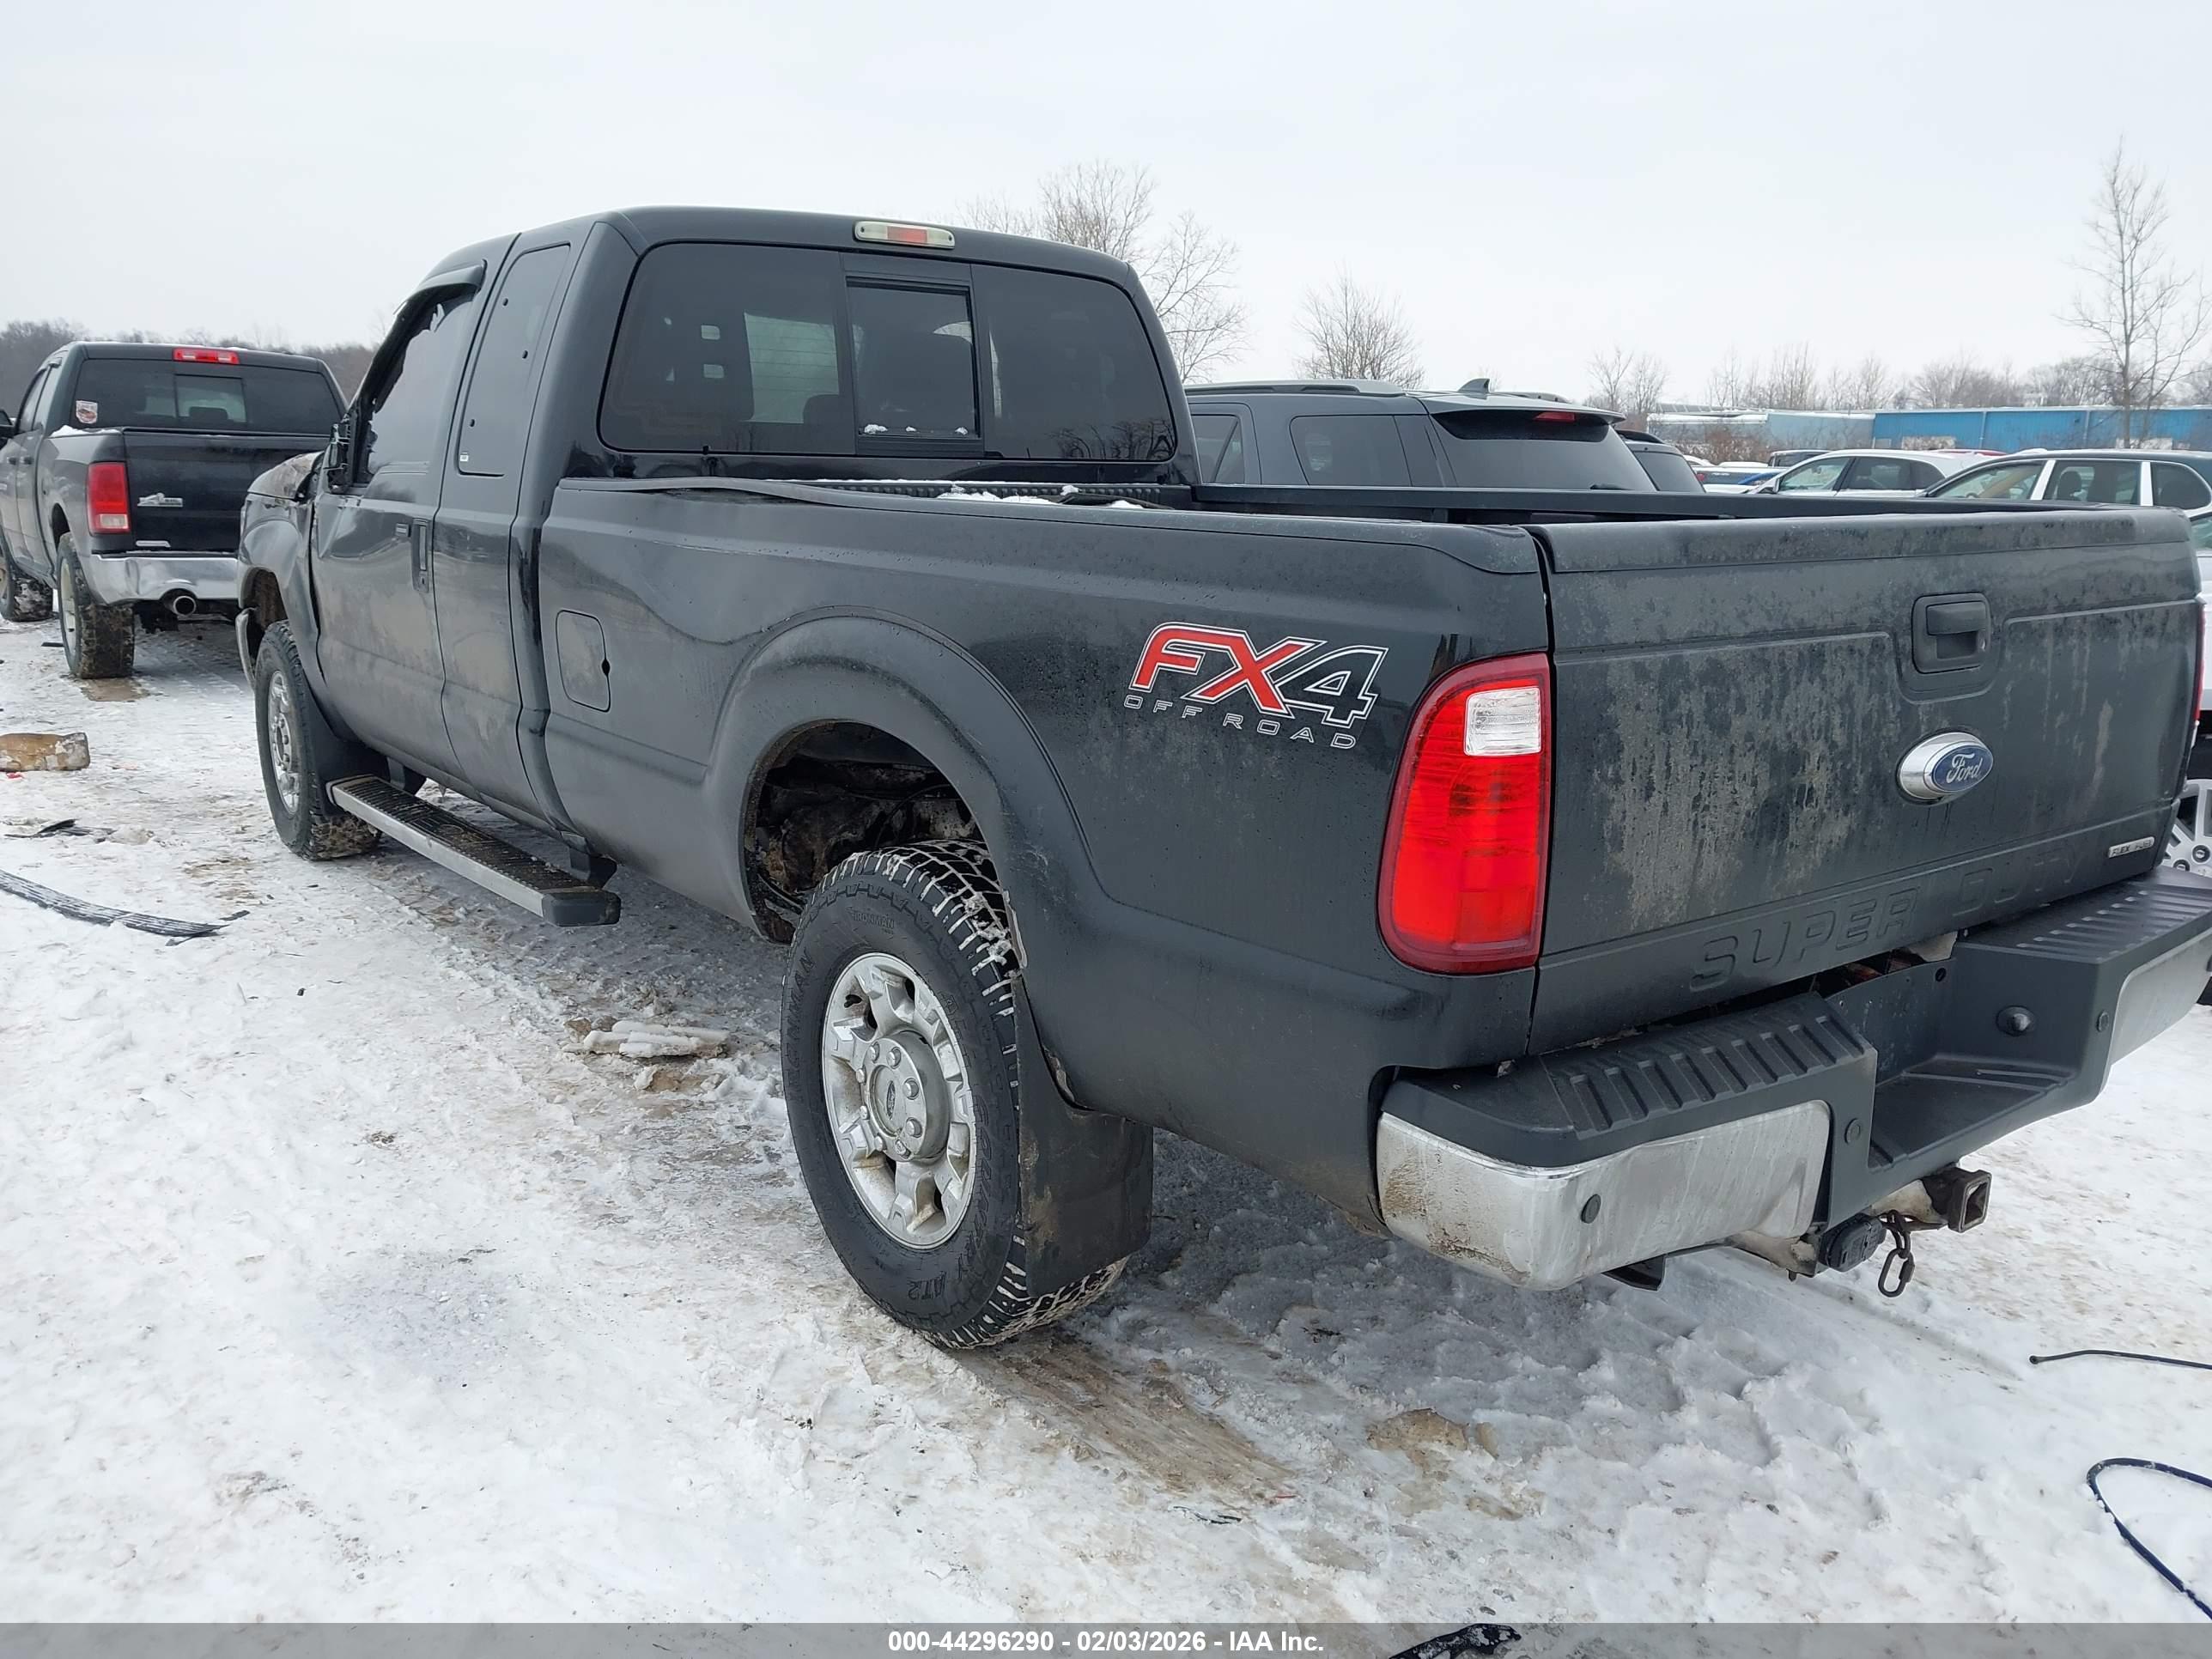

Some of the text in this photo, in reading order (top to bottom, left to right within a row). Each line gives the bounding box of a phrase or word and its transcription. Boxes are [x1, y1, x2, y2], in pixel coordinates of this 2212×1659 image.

[1128, 622, 1389, 728] FX4
[1123, 694, 1356, 750] OFF ROAD
[1946, 753, 1984, 784] Ford
[1689, 886, 1920, 993] SUPER
[908, 1273, 946, 1301] AT2
